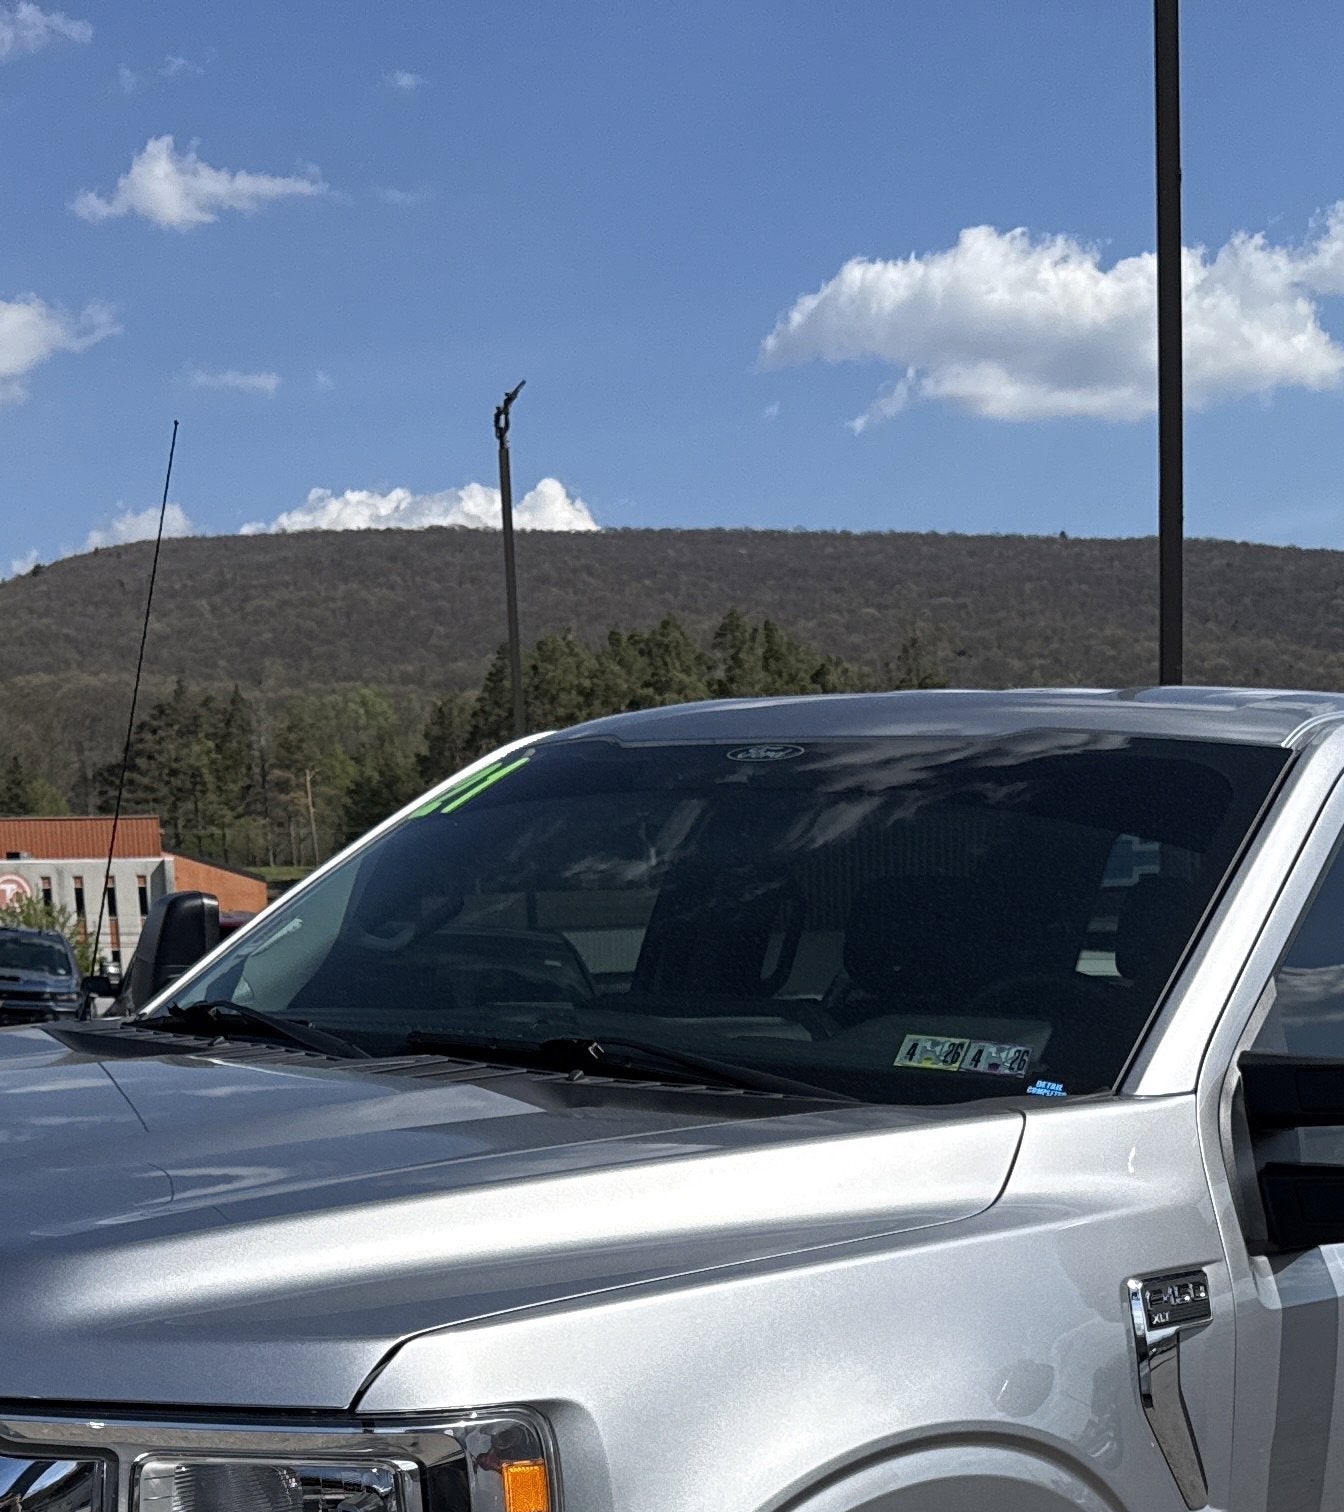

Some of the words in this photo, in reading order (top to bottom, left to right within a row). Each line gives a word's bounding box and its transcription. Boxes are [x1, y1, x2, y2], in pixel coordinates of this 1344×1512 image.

[906, 1042, 919, 1062] 4
[943, 1042, 964, 1065] 26
[970, 1048, 985, 1069] 4
[1009, 1049, 1031, 1071] 26
[1146, 1283, 1208, 1310] F-150
[1151, 1311, 1171, 1325] XLT
